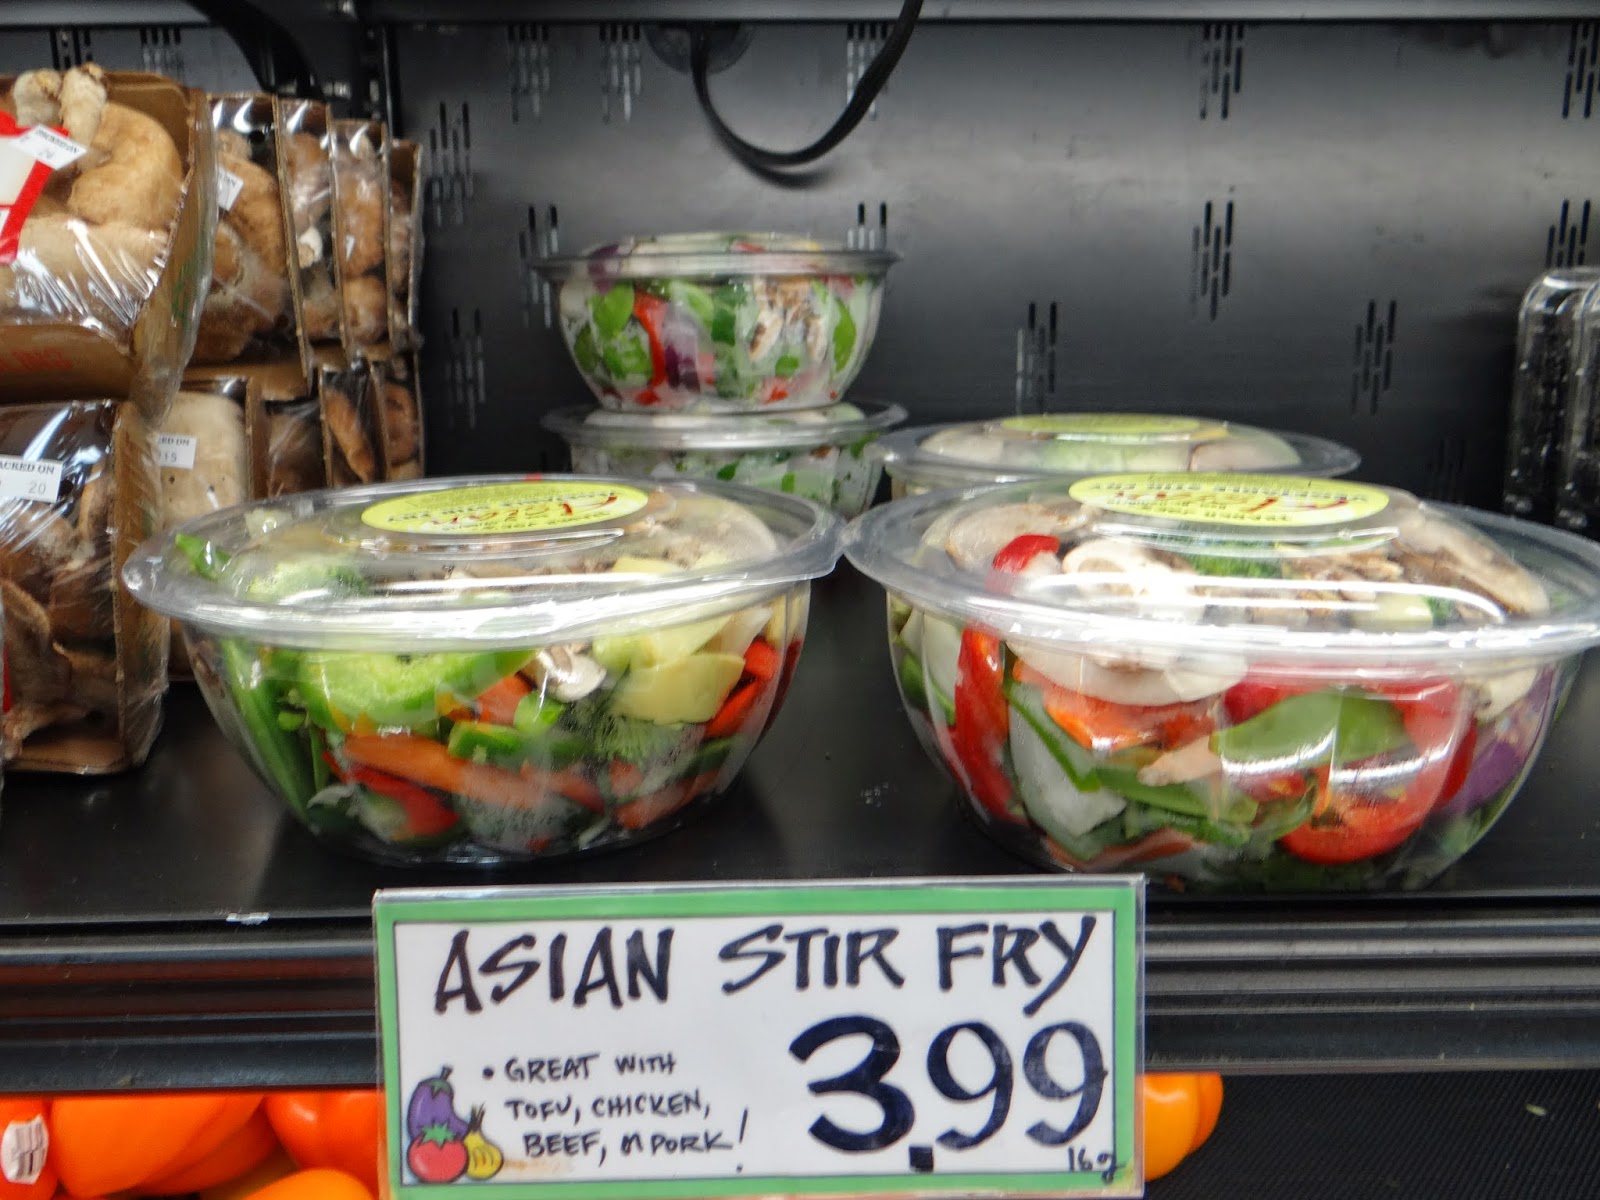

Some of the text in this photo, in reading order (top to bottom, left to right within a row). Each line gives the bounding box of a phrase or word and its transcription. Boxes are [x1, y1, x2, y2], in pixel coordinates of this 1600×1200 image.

[28, 480, 47, 495] 20
[37, 464, 55, 475] ON
[434, 915, 1097, 1017] ASIAN STIR FRY
[503, 1051, 677, 1084] GREAT WITH
[503, 1087, 711, 1126] TOFU, CHICKEN,
[788, 1014, 1109, 1173] 3.99
[523, 1130, 608, 1169] BEEF,
